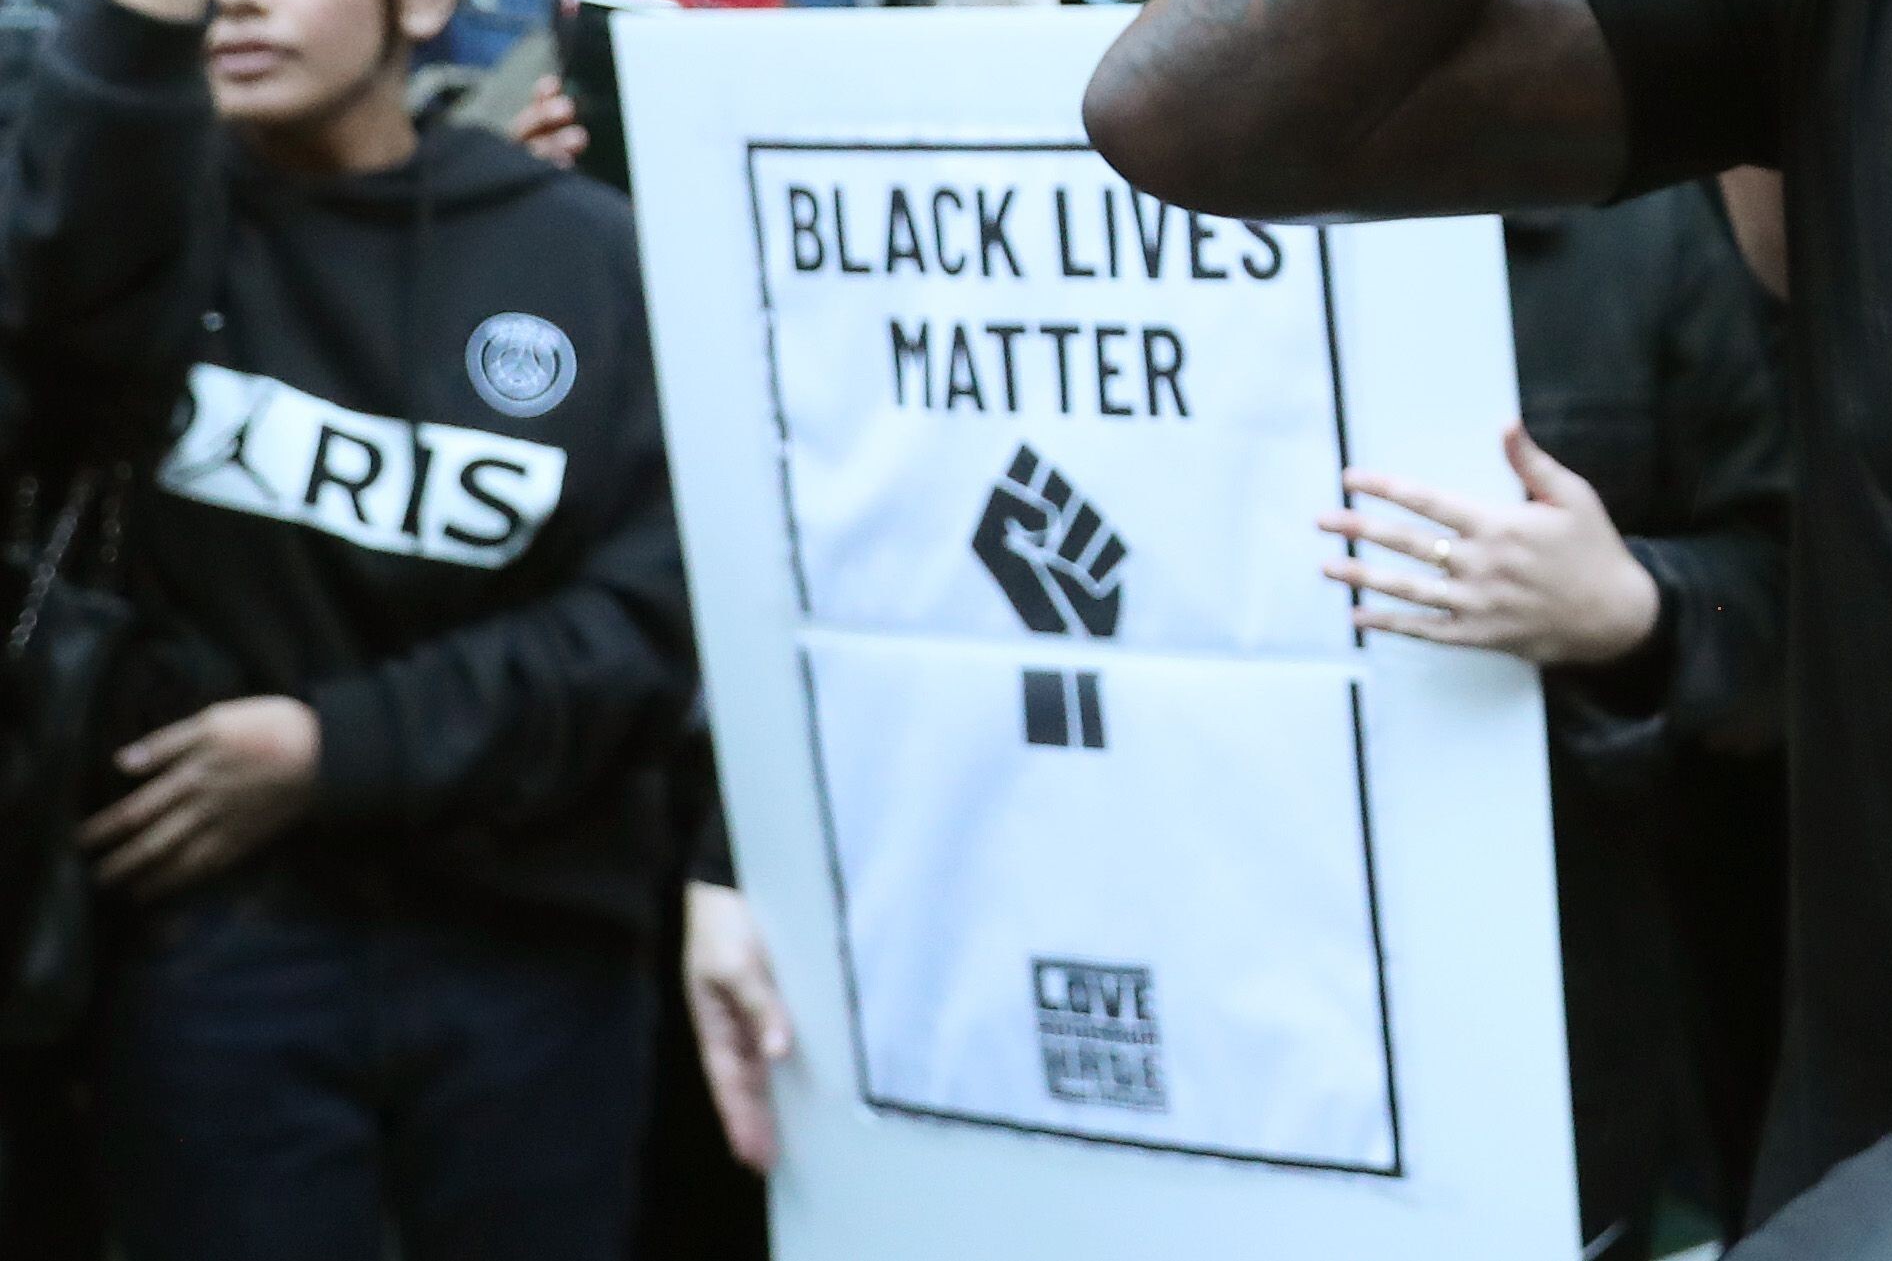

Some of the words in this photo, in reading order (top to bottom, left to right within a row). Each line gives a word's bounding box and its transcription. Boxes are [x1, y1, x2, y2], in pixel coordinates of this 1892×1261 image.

[788, 186, 1023, 277] BLACK
[1055, 186, 1283, 280] LIVES
[889, 311, 1189, 418] MATTER
